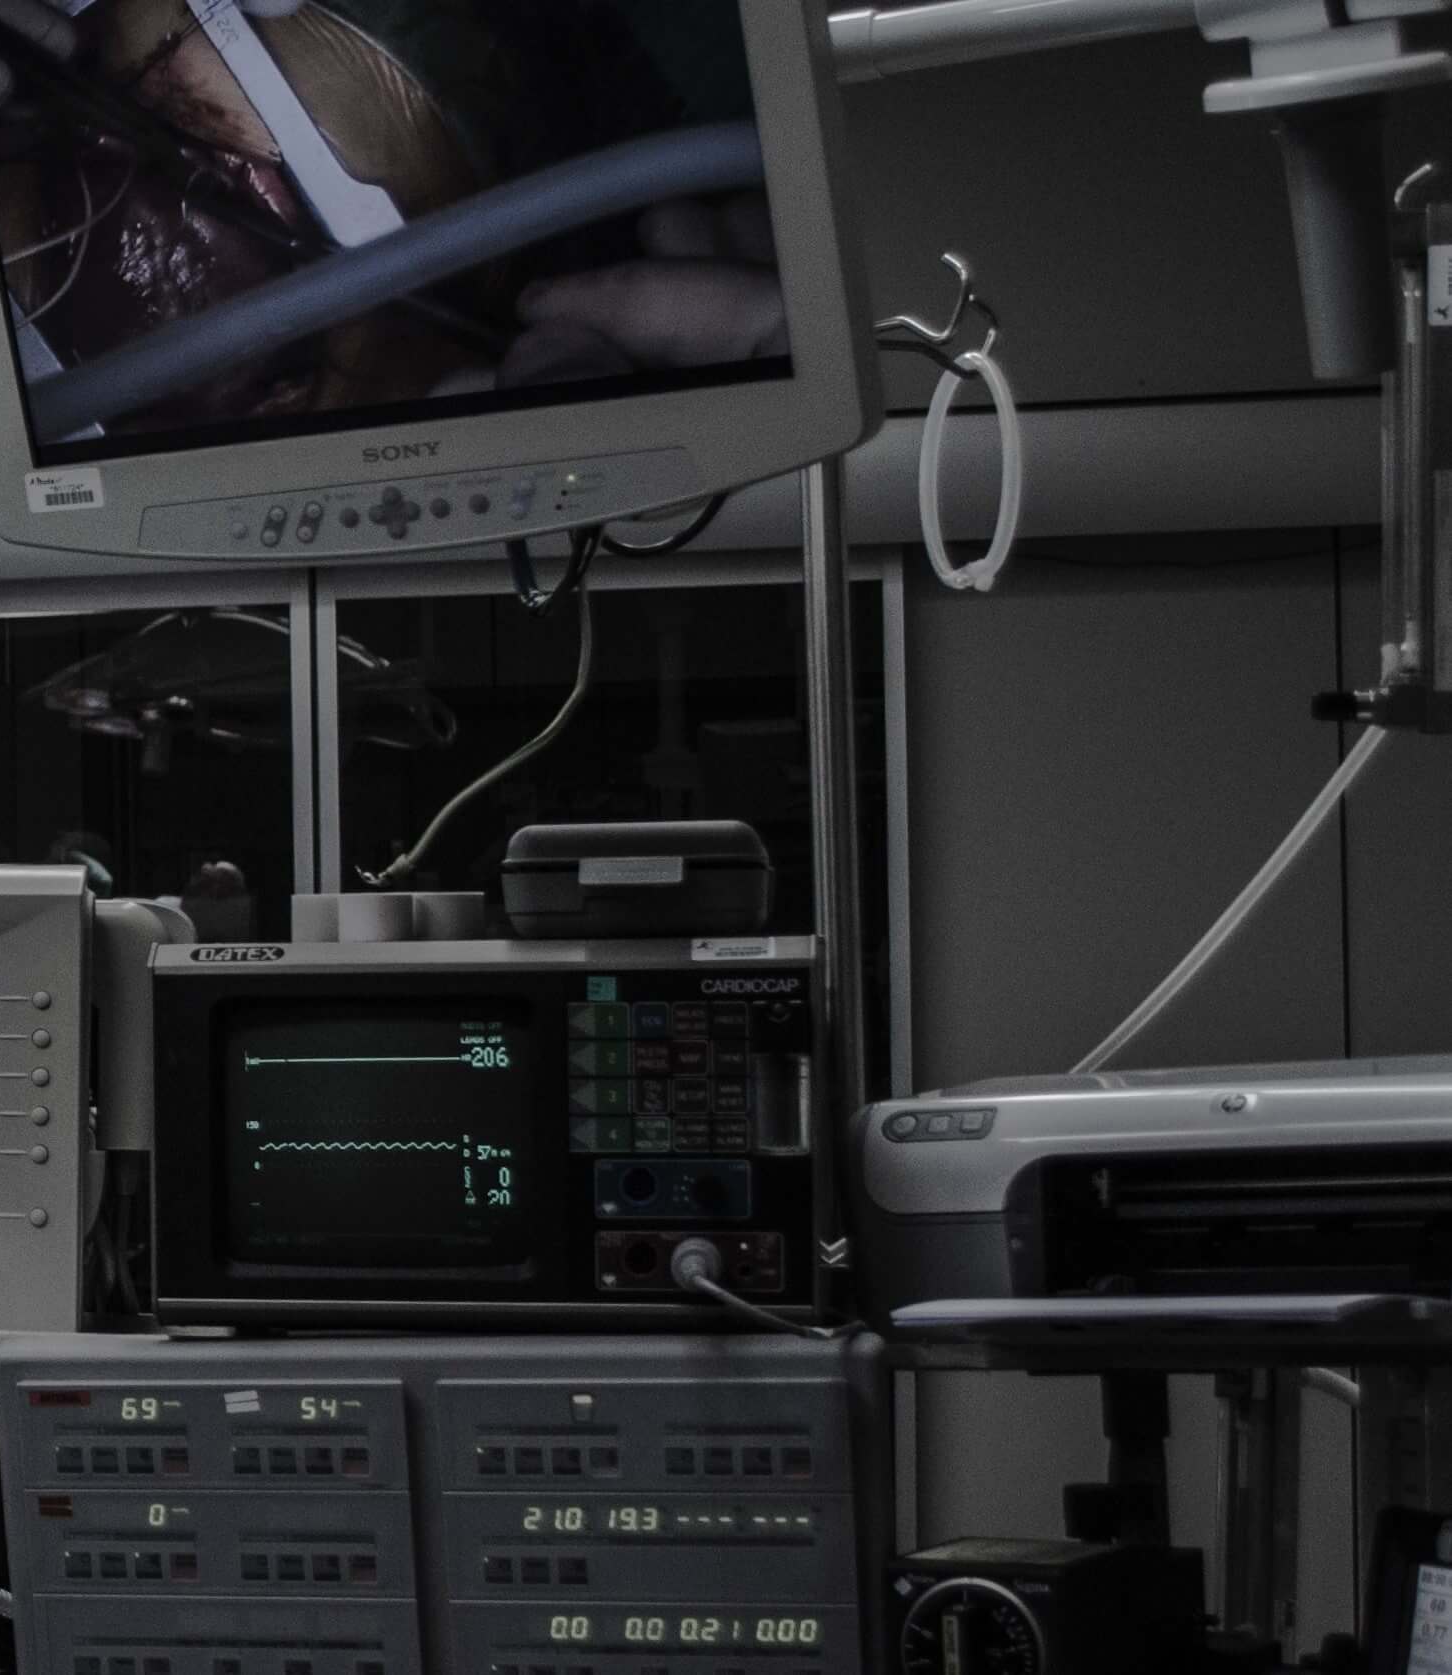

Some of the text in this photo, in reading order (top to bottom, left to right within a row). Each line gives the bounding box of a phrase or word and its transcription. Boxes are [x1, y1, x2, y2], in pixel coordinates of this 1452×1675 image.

[362, 440, 442, 463] SONY
[198, 947, 277, 961] DATEX
[700, 977, 799, 994] CARDIOCAP
[470, 1046, 509, 1068] 206
[499, 1166, 511, 1188] 0
[120, 1398, 157, 1420] 69
[300, 1398, 337, 1420] 54
[148, 1504, 164, 1526] 0
